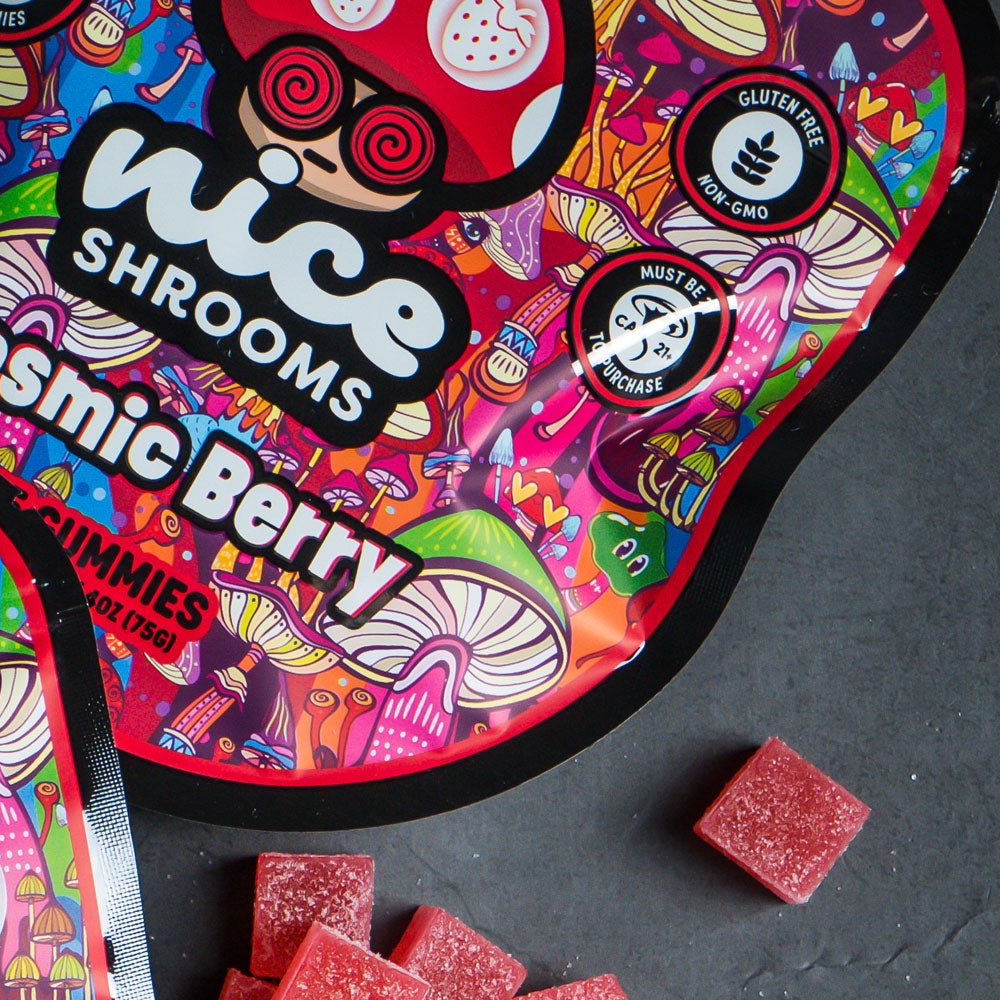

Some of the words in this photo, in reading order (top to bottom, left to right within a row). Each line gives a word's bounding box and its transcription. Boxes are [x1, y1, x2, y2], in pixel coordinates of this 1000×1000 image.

[739, 89, 800, 115] GLUTEN
[796, 109, 825, 148] FREE
[697, 174, 769, 220] NON-GMO
[82, 128, 445, 379] nice
[641, 265, 686, 285] MUST
[684, 278, 707, 299] BE
[73, 227, 372, 422] SHROOMS
[181, 442, 407, 617] Berry
[121, 609, 177, 653] (75G)
